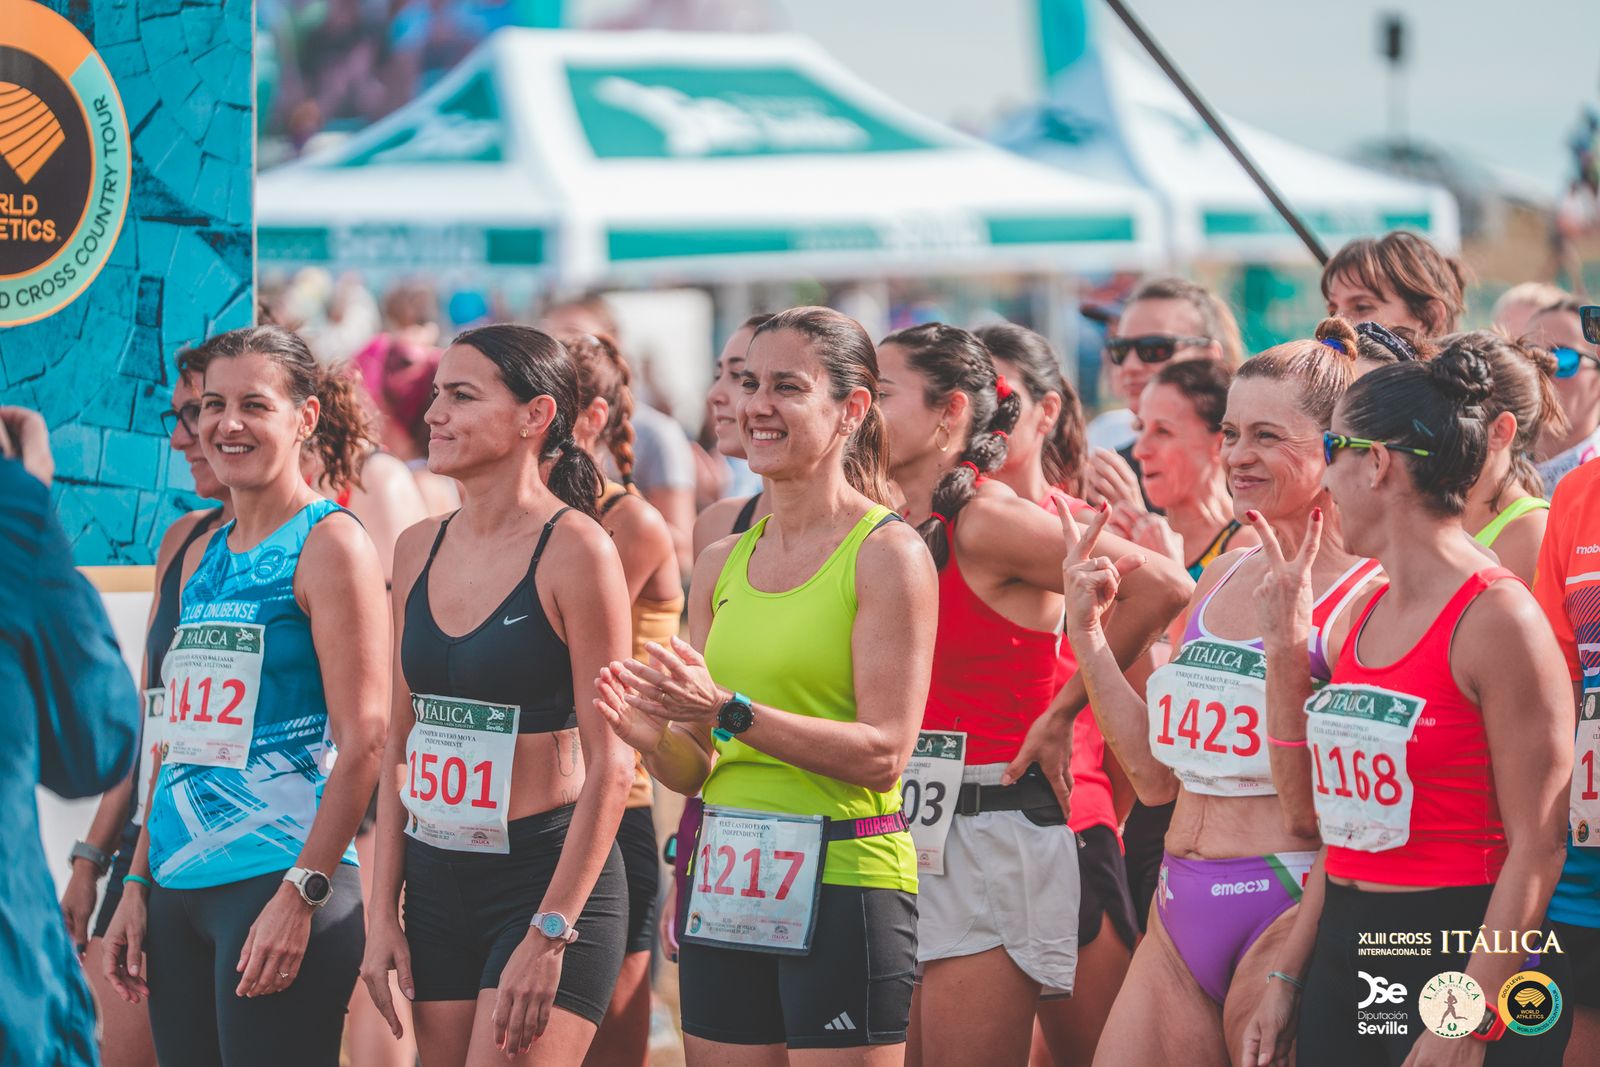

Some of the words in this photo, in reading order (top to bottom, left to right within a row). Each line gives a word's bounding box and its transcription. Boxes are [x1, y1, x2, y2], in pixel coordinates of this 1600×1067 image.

[94, 95, 117, 156] TOUR
[75, 163, 118, 266] COUNTRY
[16, 263, 77, 306] CROSS
[1188, 644, 1244, 668] ITÁLICA
[169, 676, 246, 726] 1412
[1157, 694, 1261, 757] 1423
[410, 750, 497, 809] 1501
[1313, 743, 1402, 806] 1168
[1581, 750, 1598, 800] 1
[855, 814, 899, 837] DORSAL
[902, 779, 946, 827] 03
[697, 843, 805, 900] 1217
[1211, 881, 1256, 896] emec
